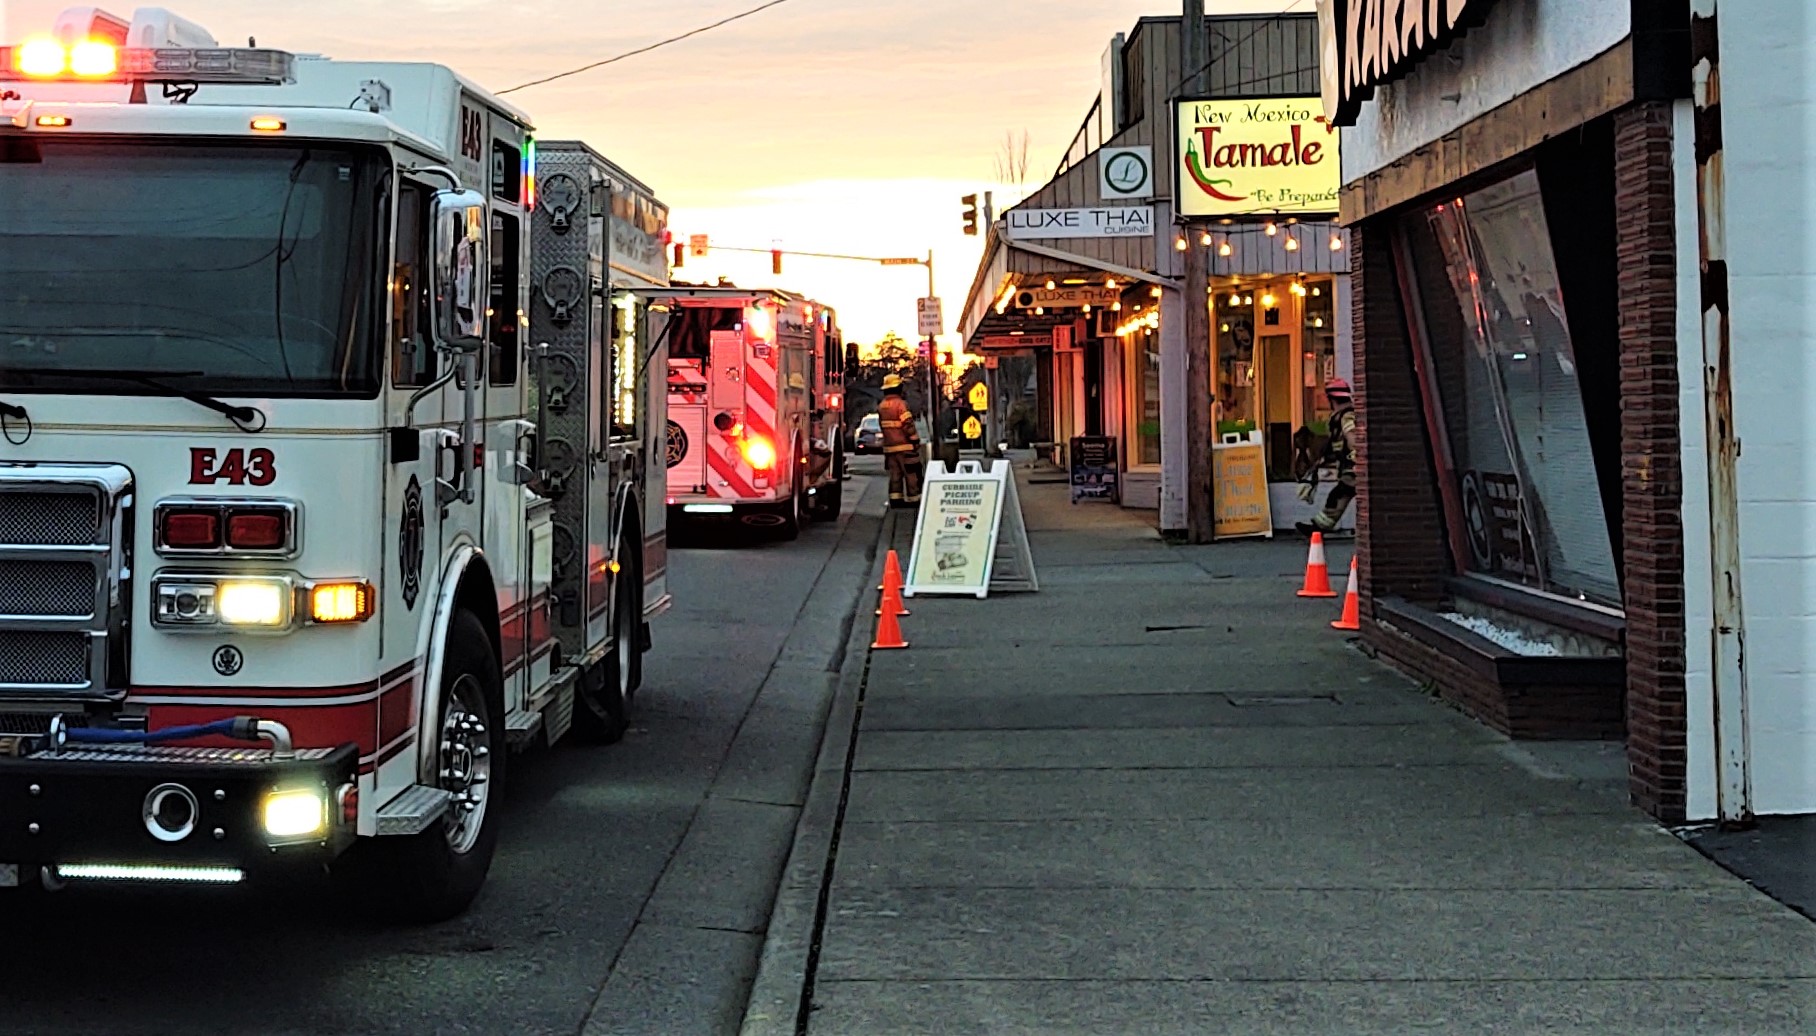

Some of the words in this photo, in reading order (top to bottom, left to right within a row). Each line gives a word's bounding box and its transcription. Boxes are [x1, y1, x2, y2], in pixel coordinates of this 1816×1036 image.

[1194, 103, 1233, 124] New
[1240, 103, 1310, 124] Mexico
[461, 104, 481, 163] E43
[1194, 125, 1324, 168] Tamale
[1012, 211, 1080, 228] LUXE
[1089, 208, 1149, 226] THAI
[1104, 225, 1150, 234] CUISINE
[1036, 289, 1076, 302] LUXE
[1081, 288, 1118, 300] THAI
[187, 447, 277, 487] E43
